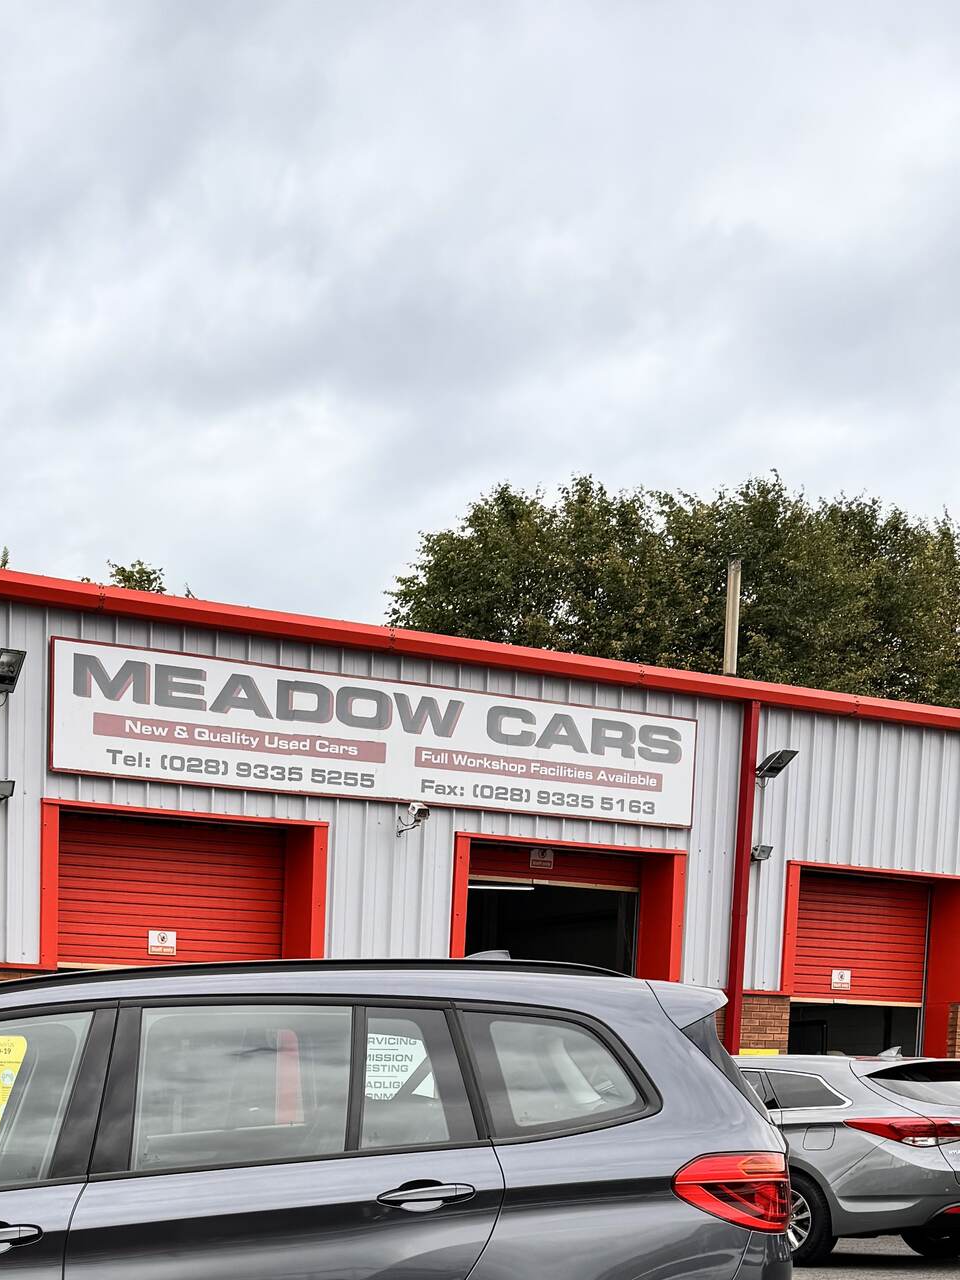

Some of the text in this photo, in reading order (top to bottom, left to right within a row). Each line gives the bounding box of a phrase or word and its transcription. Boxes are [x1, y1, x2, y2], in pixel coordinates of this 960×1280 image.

[72, 652, 683, 764] MEADOW CARS
[125, 720, 359, 756] New & Quality Used Cars
[106, 748, 376, 789] Tel: (028) 9335 5255
[421, 751, 657, 787] Full Workshop Facilities Available
[421, 778, 656, 815] Fax: (028) 9335 5163
